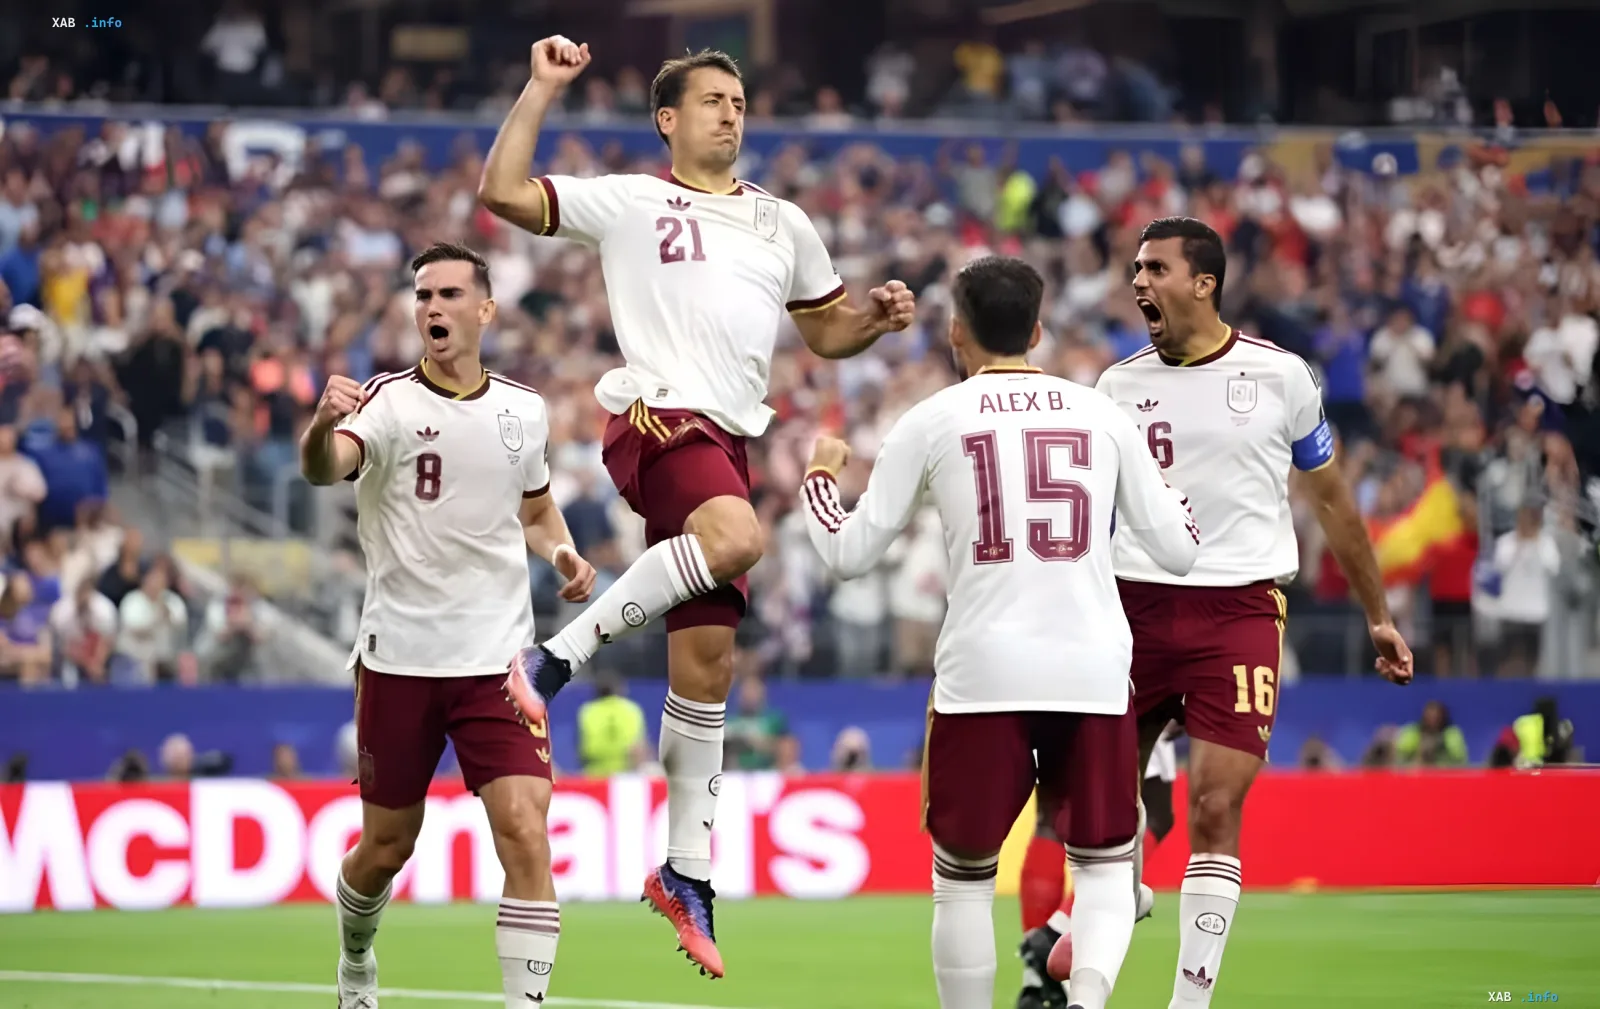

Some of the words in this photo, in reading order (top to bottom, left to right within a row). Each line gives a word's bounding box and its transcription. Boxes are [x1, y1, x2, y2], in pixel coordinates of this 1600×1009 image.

[656, 216, 706, 265] 21
[980, 391, 1041, 413] ALEX
[1047, 391, 1071, 411] B.
[415, 452, 442, 501] 8
[961, 428, 1092, 565] 15
[1233, 664, 1275, 716] 16
